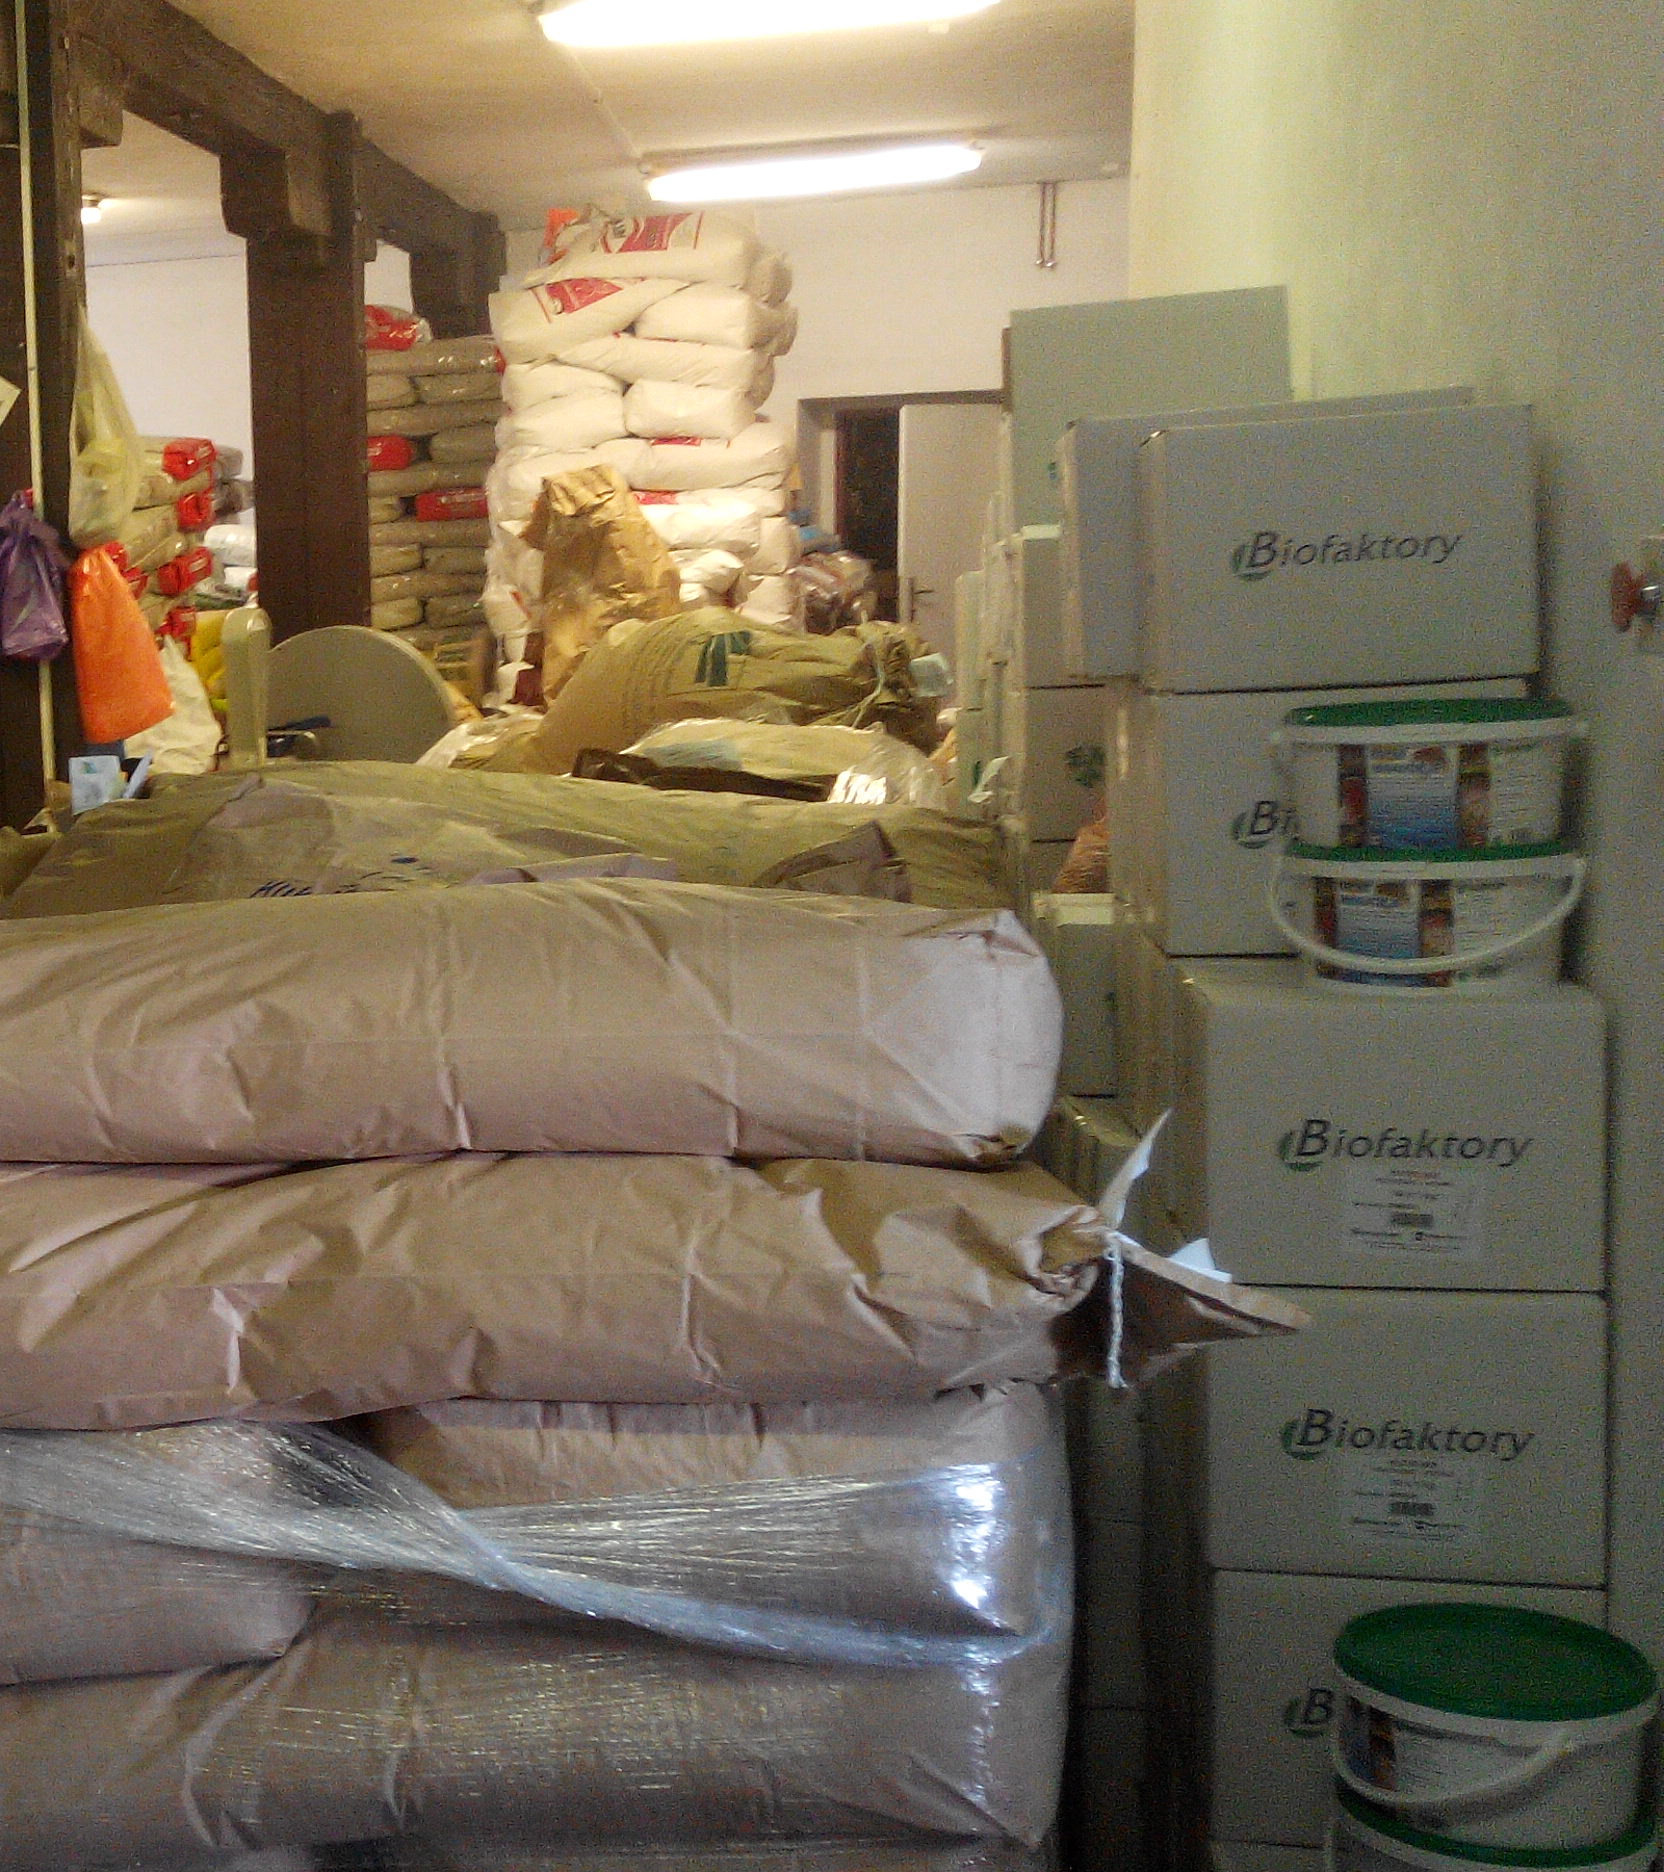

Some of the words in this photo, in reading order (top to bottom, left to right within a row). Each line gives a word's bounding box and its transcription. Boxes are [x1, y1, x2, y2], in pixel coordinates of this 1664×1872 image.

[1247, 531, 1462, 570] Biofaktory
[1296, 1119, 1533, 1167] Biofaktory
[1298, 1409, 1534, 1461] Biofaktory
